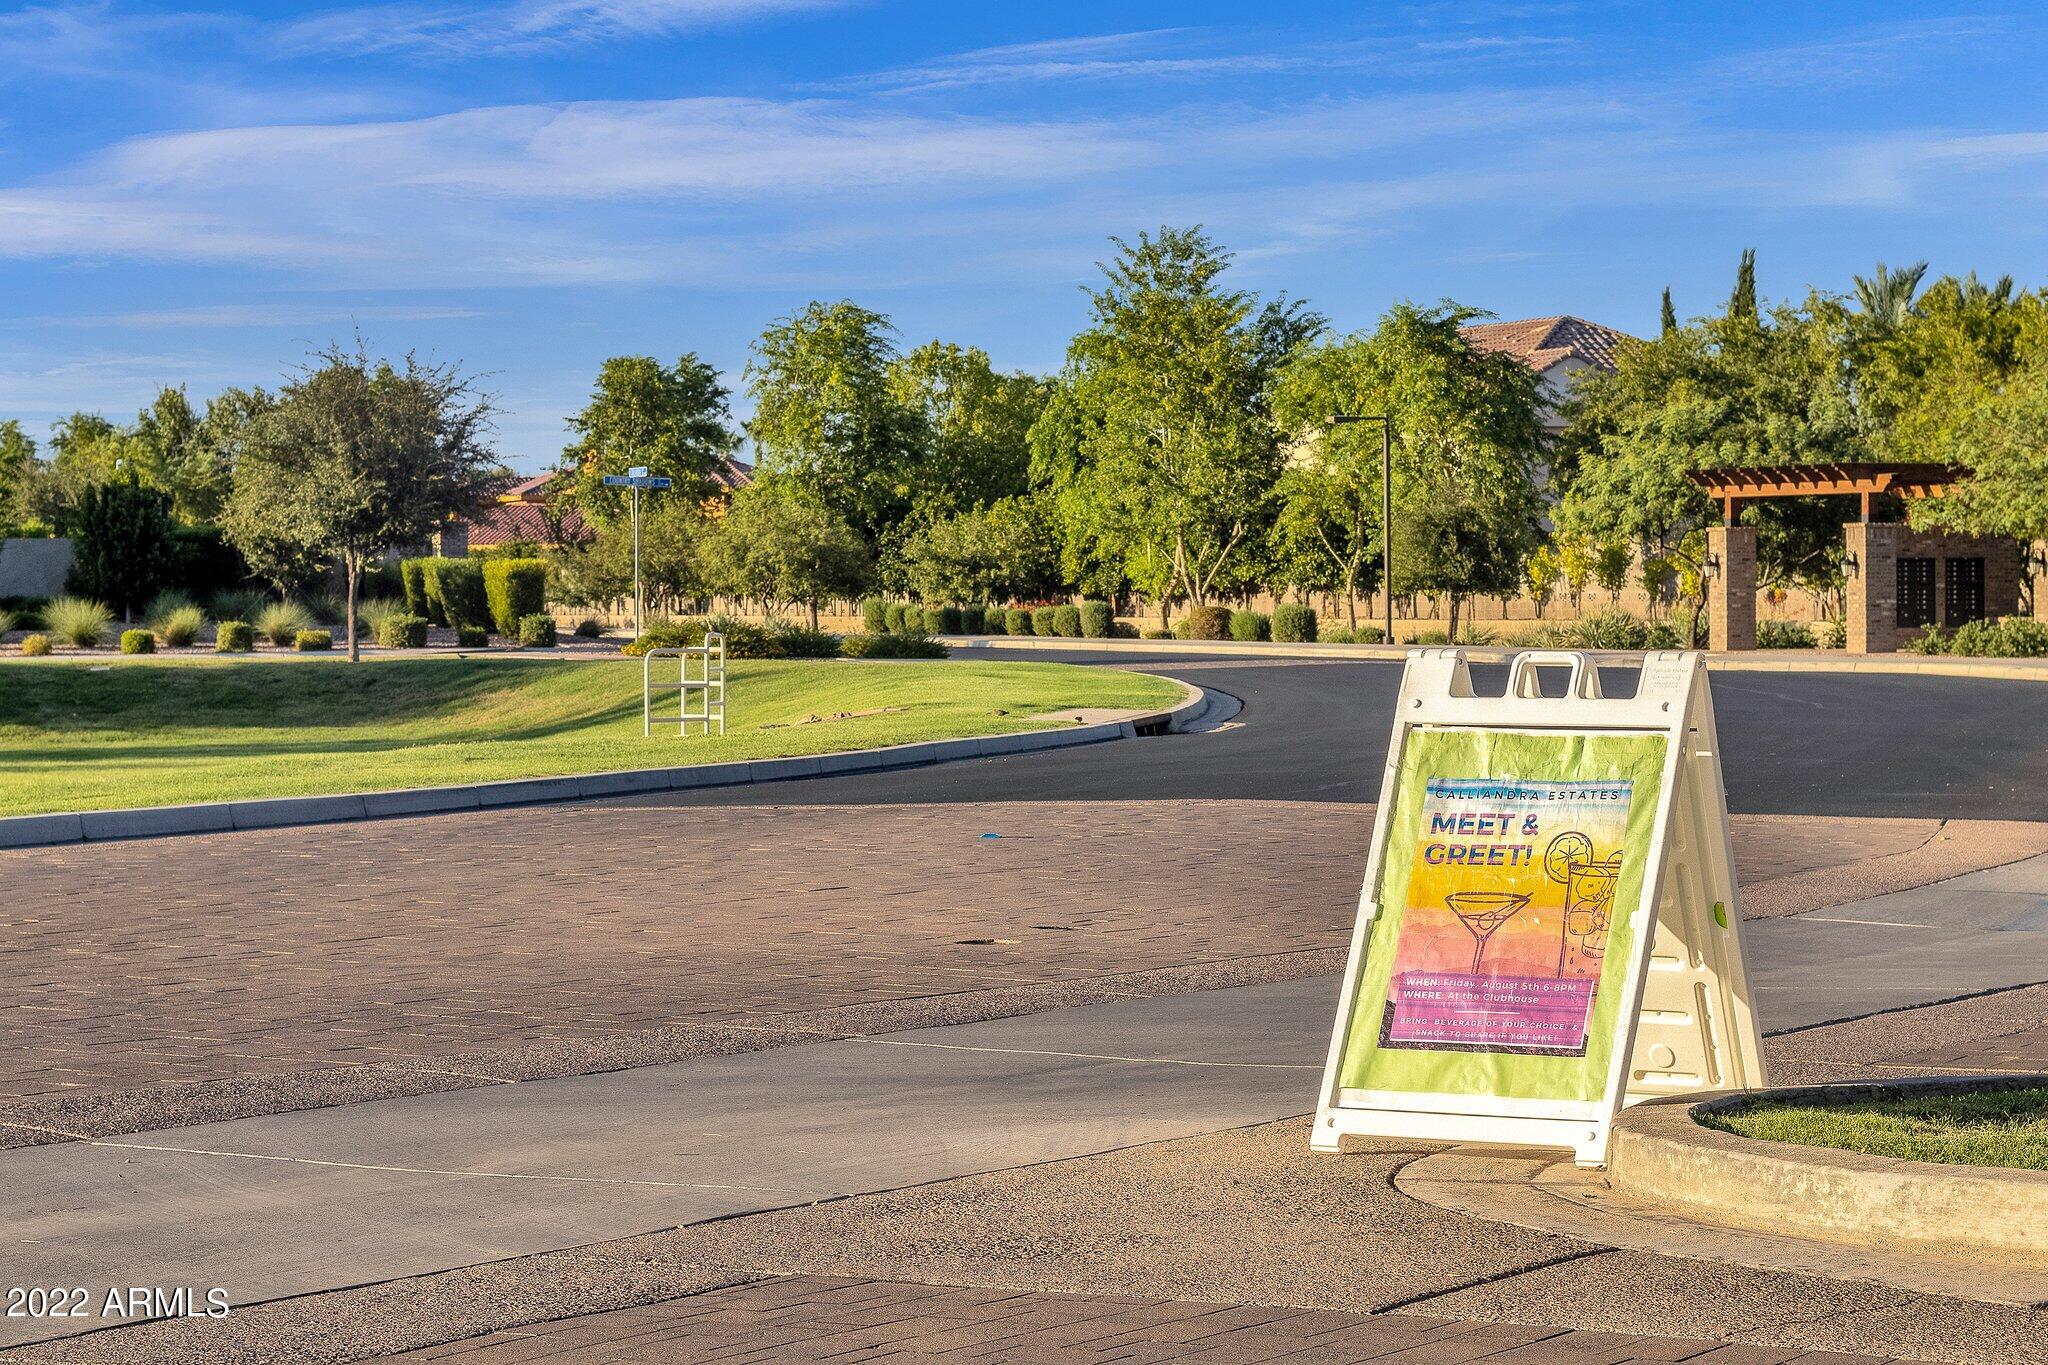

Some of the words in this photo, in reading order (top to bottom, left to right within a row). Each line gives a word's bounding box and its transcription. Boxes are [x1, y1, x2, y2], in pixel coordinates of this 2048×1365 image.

[1435, 789, 1540, 801] CALLIANDRA
[1549, 790, 1619, 801] ESTATES
[1431, 812, 1515, 836] MEET
[1521, 813, 1539, 836] &
[1424, 844, 1533, 867] GREET!
[1406, 977, 1440, 987] WHEN:
[1443, 978, 1478, 989] Friday,
[1481, 981, 1518, 991] August
[1521, 982, 1540, 991] 5th
[1543, 983, 1577, 992] 6-8PM
[1404, 990, 1445, 1000] WHERE:
[1447, 991, 1459, 1000] At
[1462, 991, 1480, 1000] the
[1483, 993, 1540, 1004] Clubhouse
[1400, 1017, 1428, 1025] BRING
[1434, 1019, 1483, 1027] BEVERAGE
[1415, 1029, 1446, 1037] SNACK
[1465, 1031, 1494, 1039] SHARE
